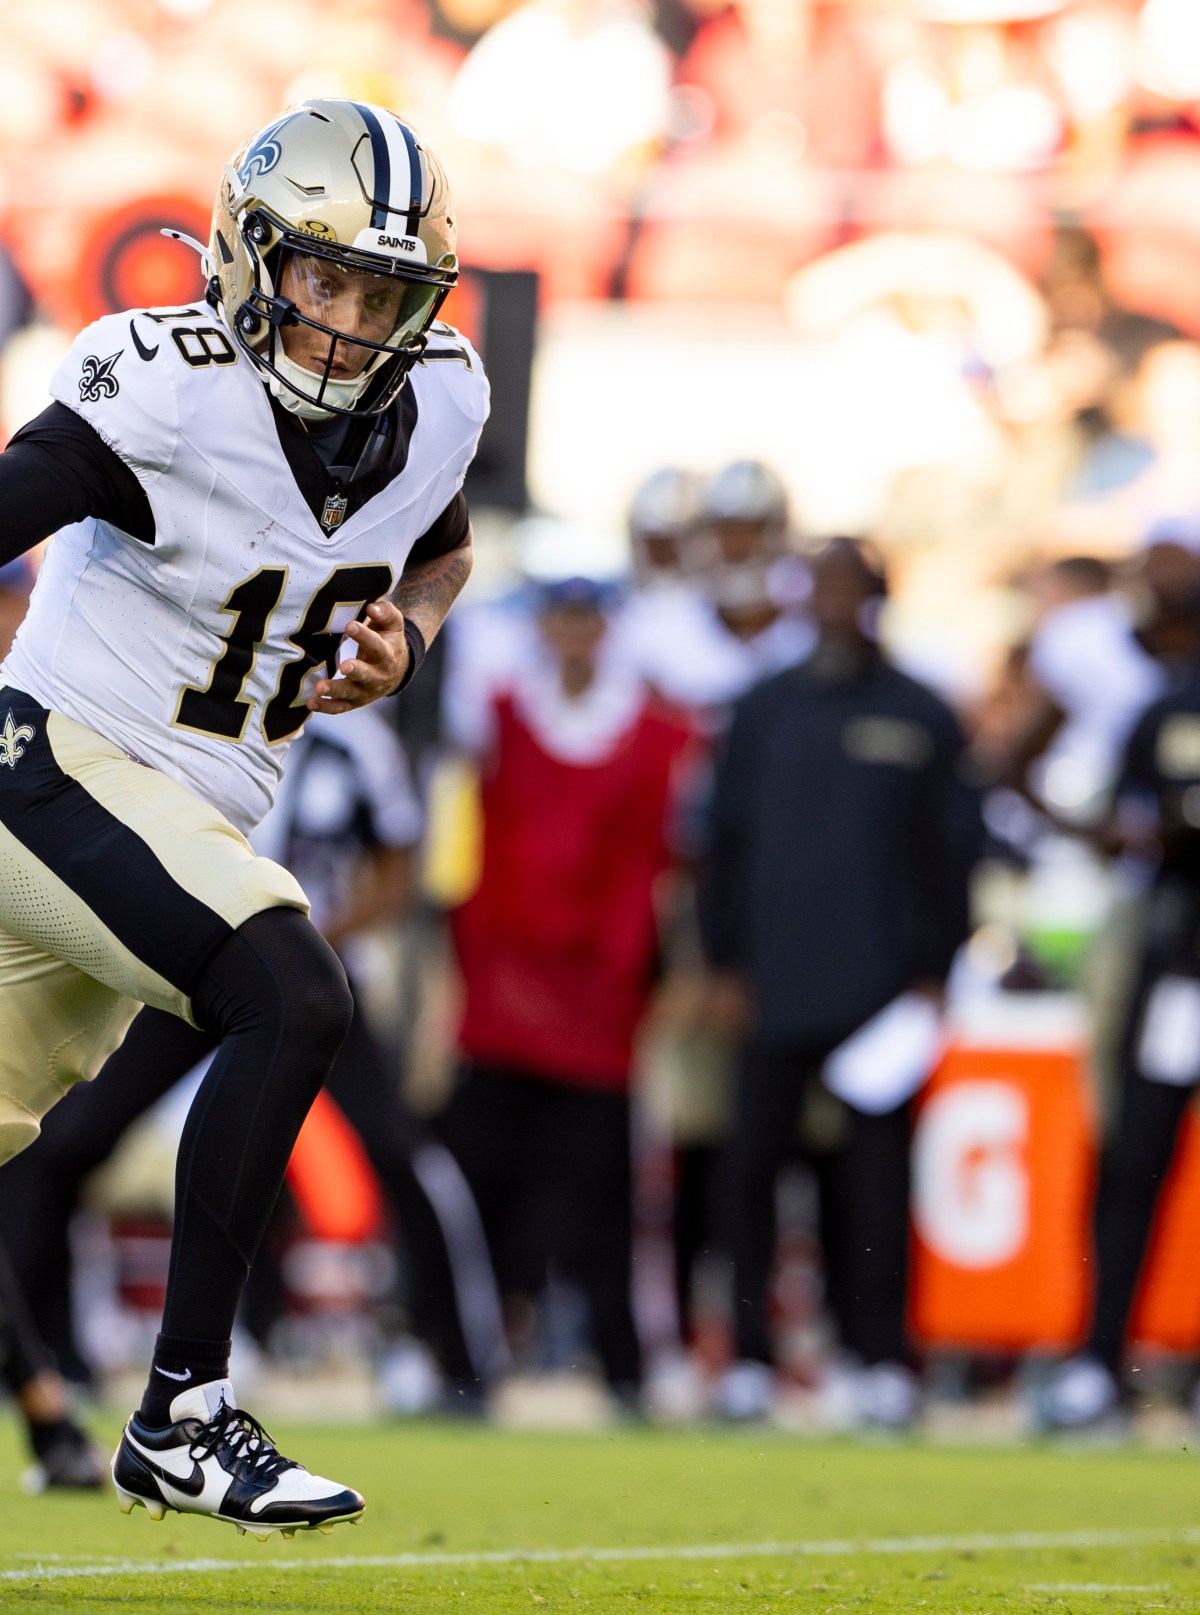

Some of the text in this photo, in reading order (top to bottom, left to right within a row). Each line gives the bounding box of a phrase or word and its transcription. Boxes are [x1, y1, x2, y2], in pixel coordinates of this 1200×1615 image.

[377, 234, 416, 252] SAINTS
[139, 307, 240, 369] 18
[323, 509, 344, 526] NFL
[170, 561, 395, 747] 18
[910, 1078, 1031, 1272] G
